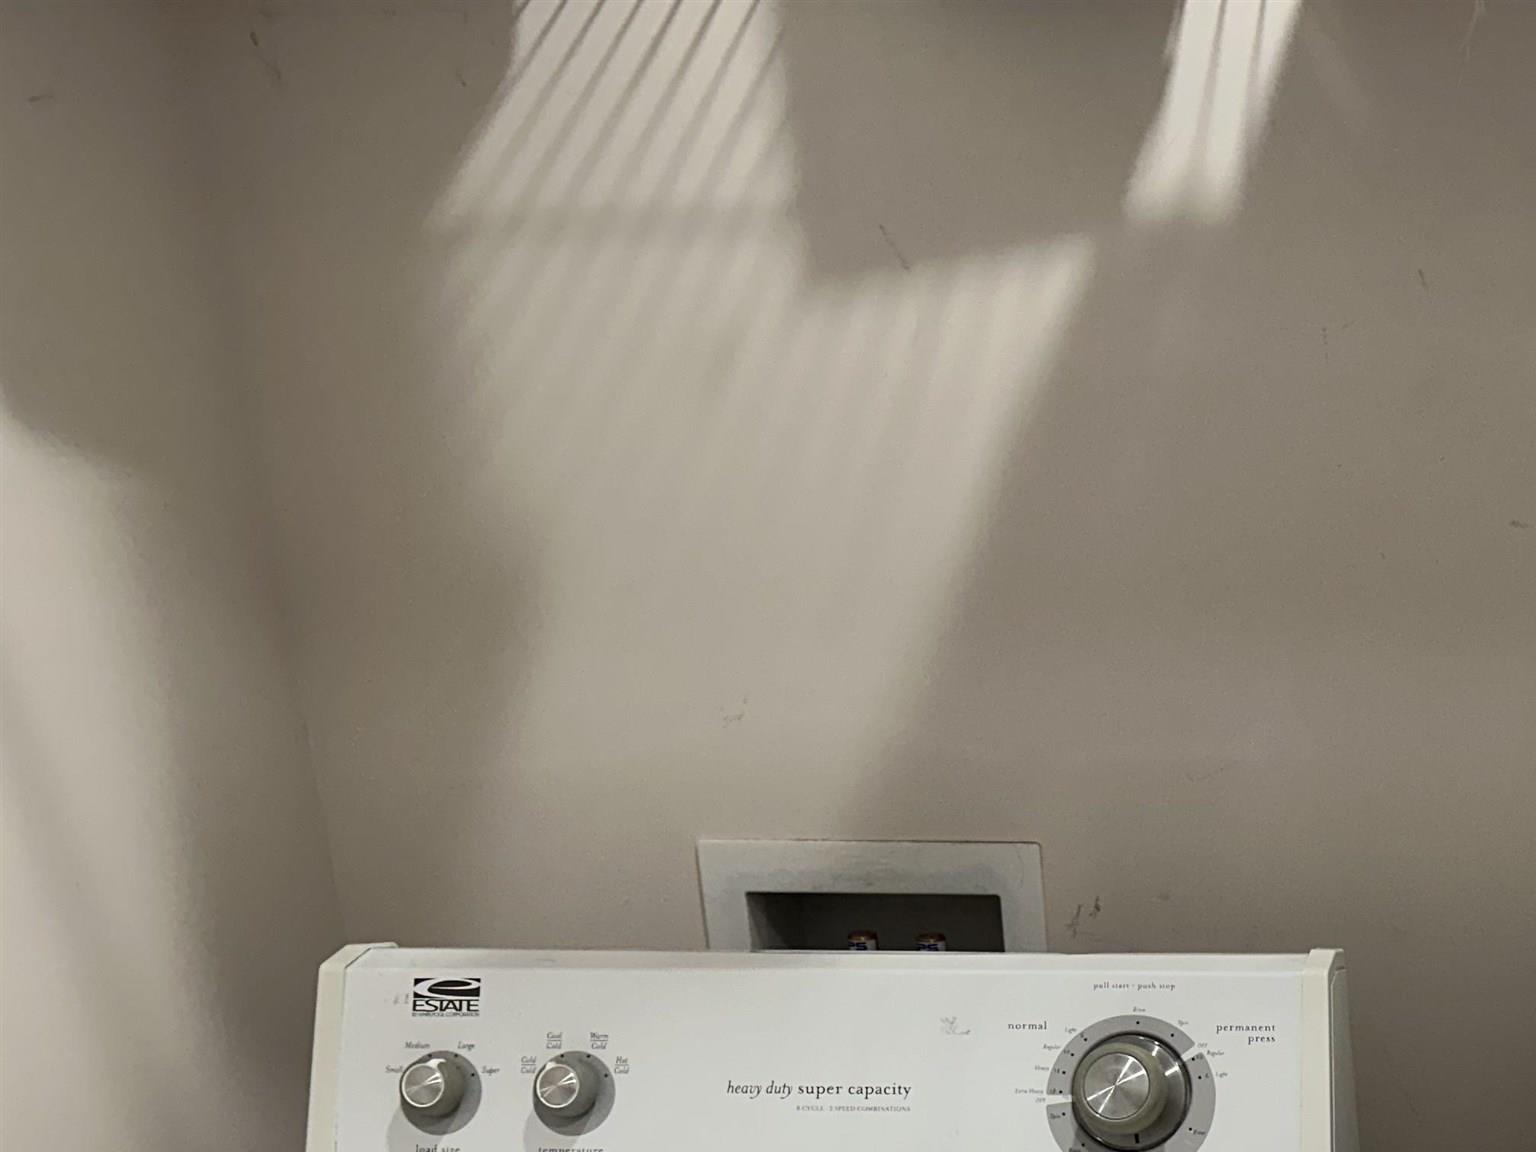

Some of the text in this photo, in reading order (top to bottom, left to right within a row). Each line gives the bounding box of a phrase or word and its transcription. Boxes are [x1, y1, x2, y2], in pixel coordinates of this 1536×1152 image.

[412, 999, 480, 1012] ESTATE
[1008, 1021, 1047, 1030] normal
[1216, 1024, 1276, 1034] permanent
[1248, 1036, 1276, 1045] press
[726, 1080, 912, 1100] heavy duty super capacity
